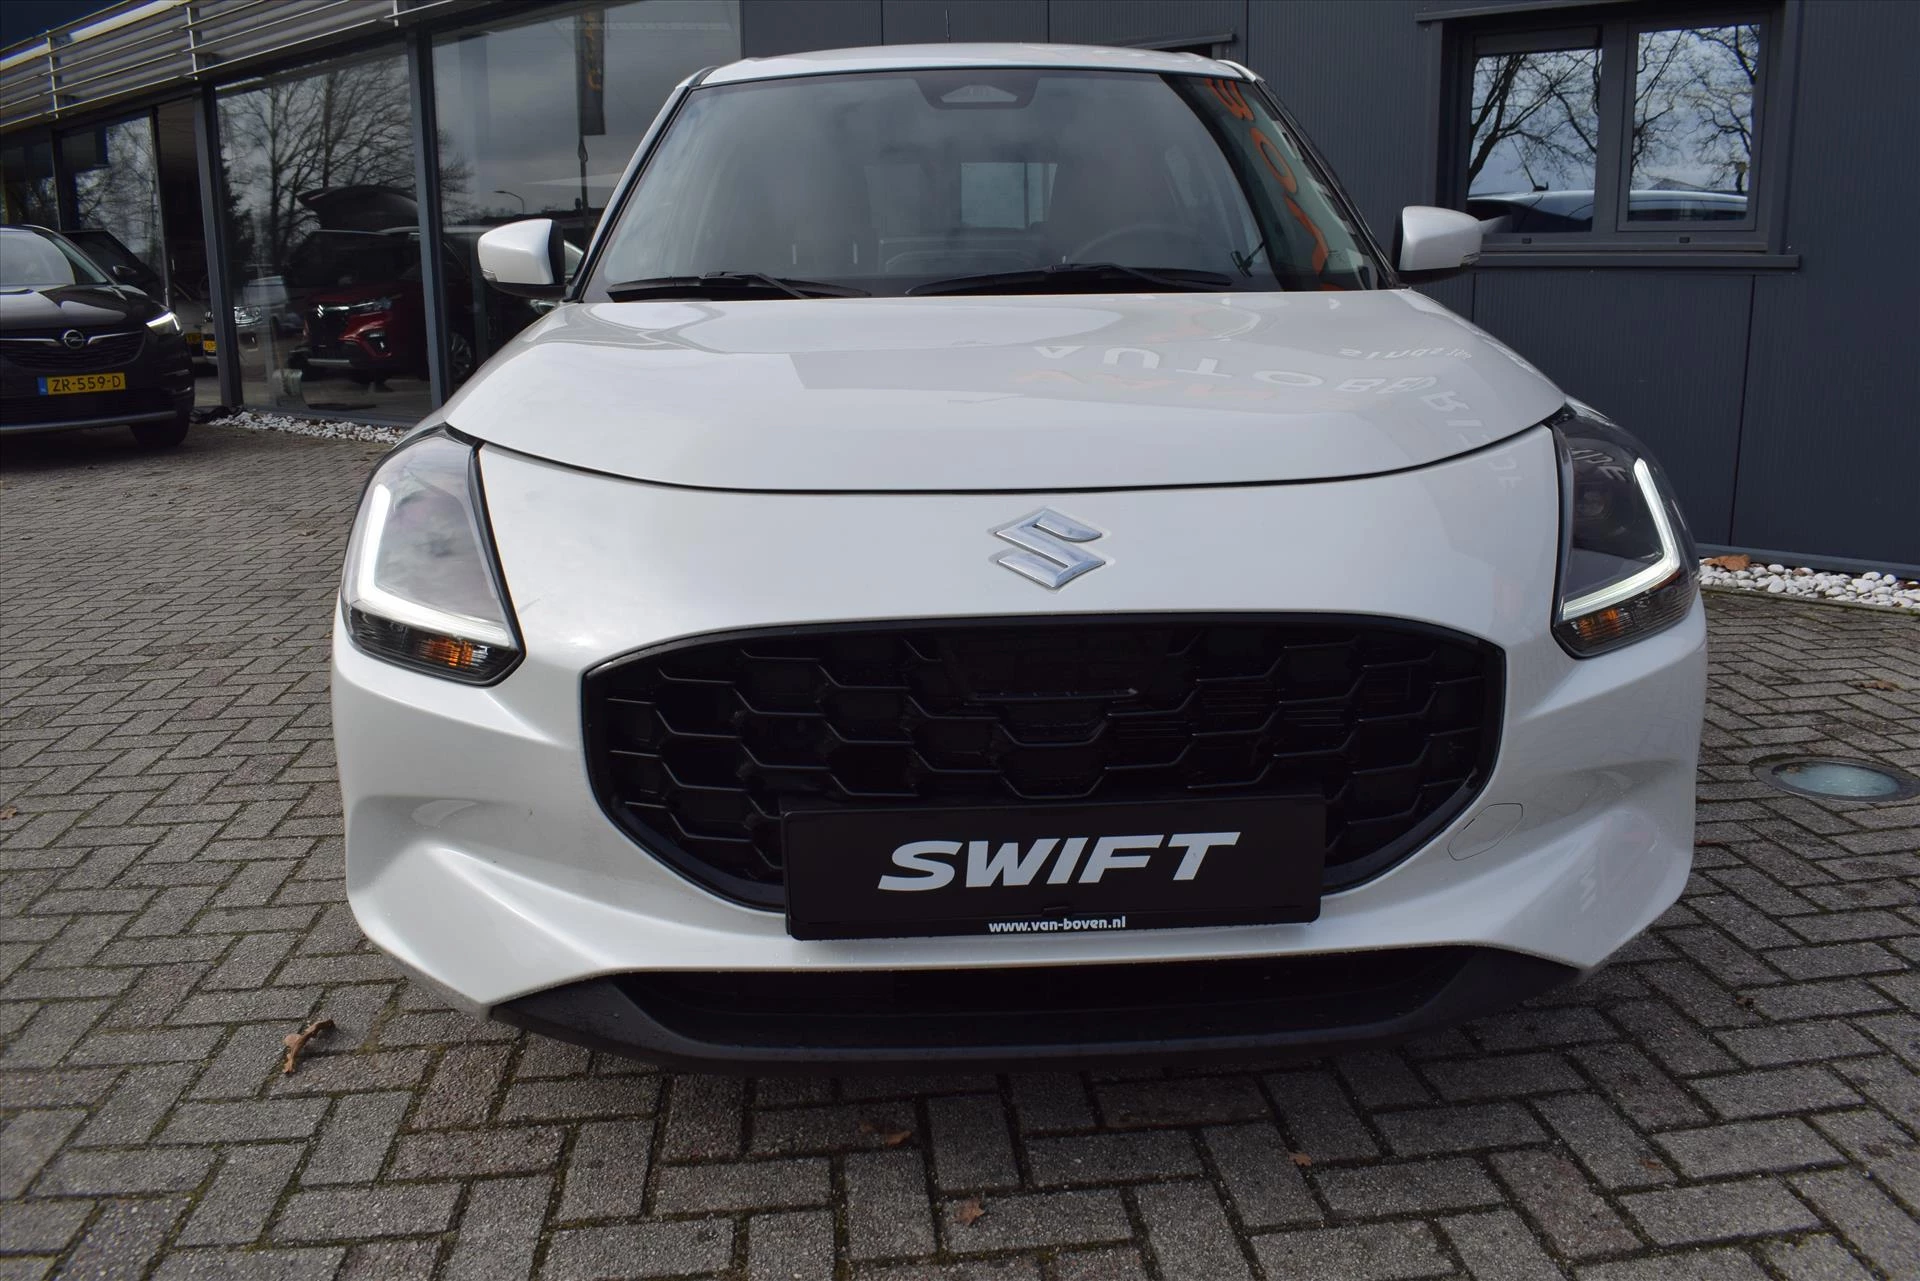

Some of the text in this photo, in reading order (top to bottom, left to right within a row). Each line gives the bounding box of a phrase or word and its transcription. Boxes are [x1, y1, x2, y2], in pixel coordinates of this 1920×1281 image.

[51, 375, 121, 392] ZR-559-D
[877, 831, 1241, 892] SWIFT
[988, 915, 1126, 932] www.van-boven.nl
